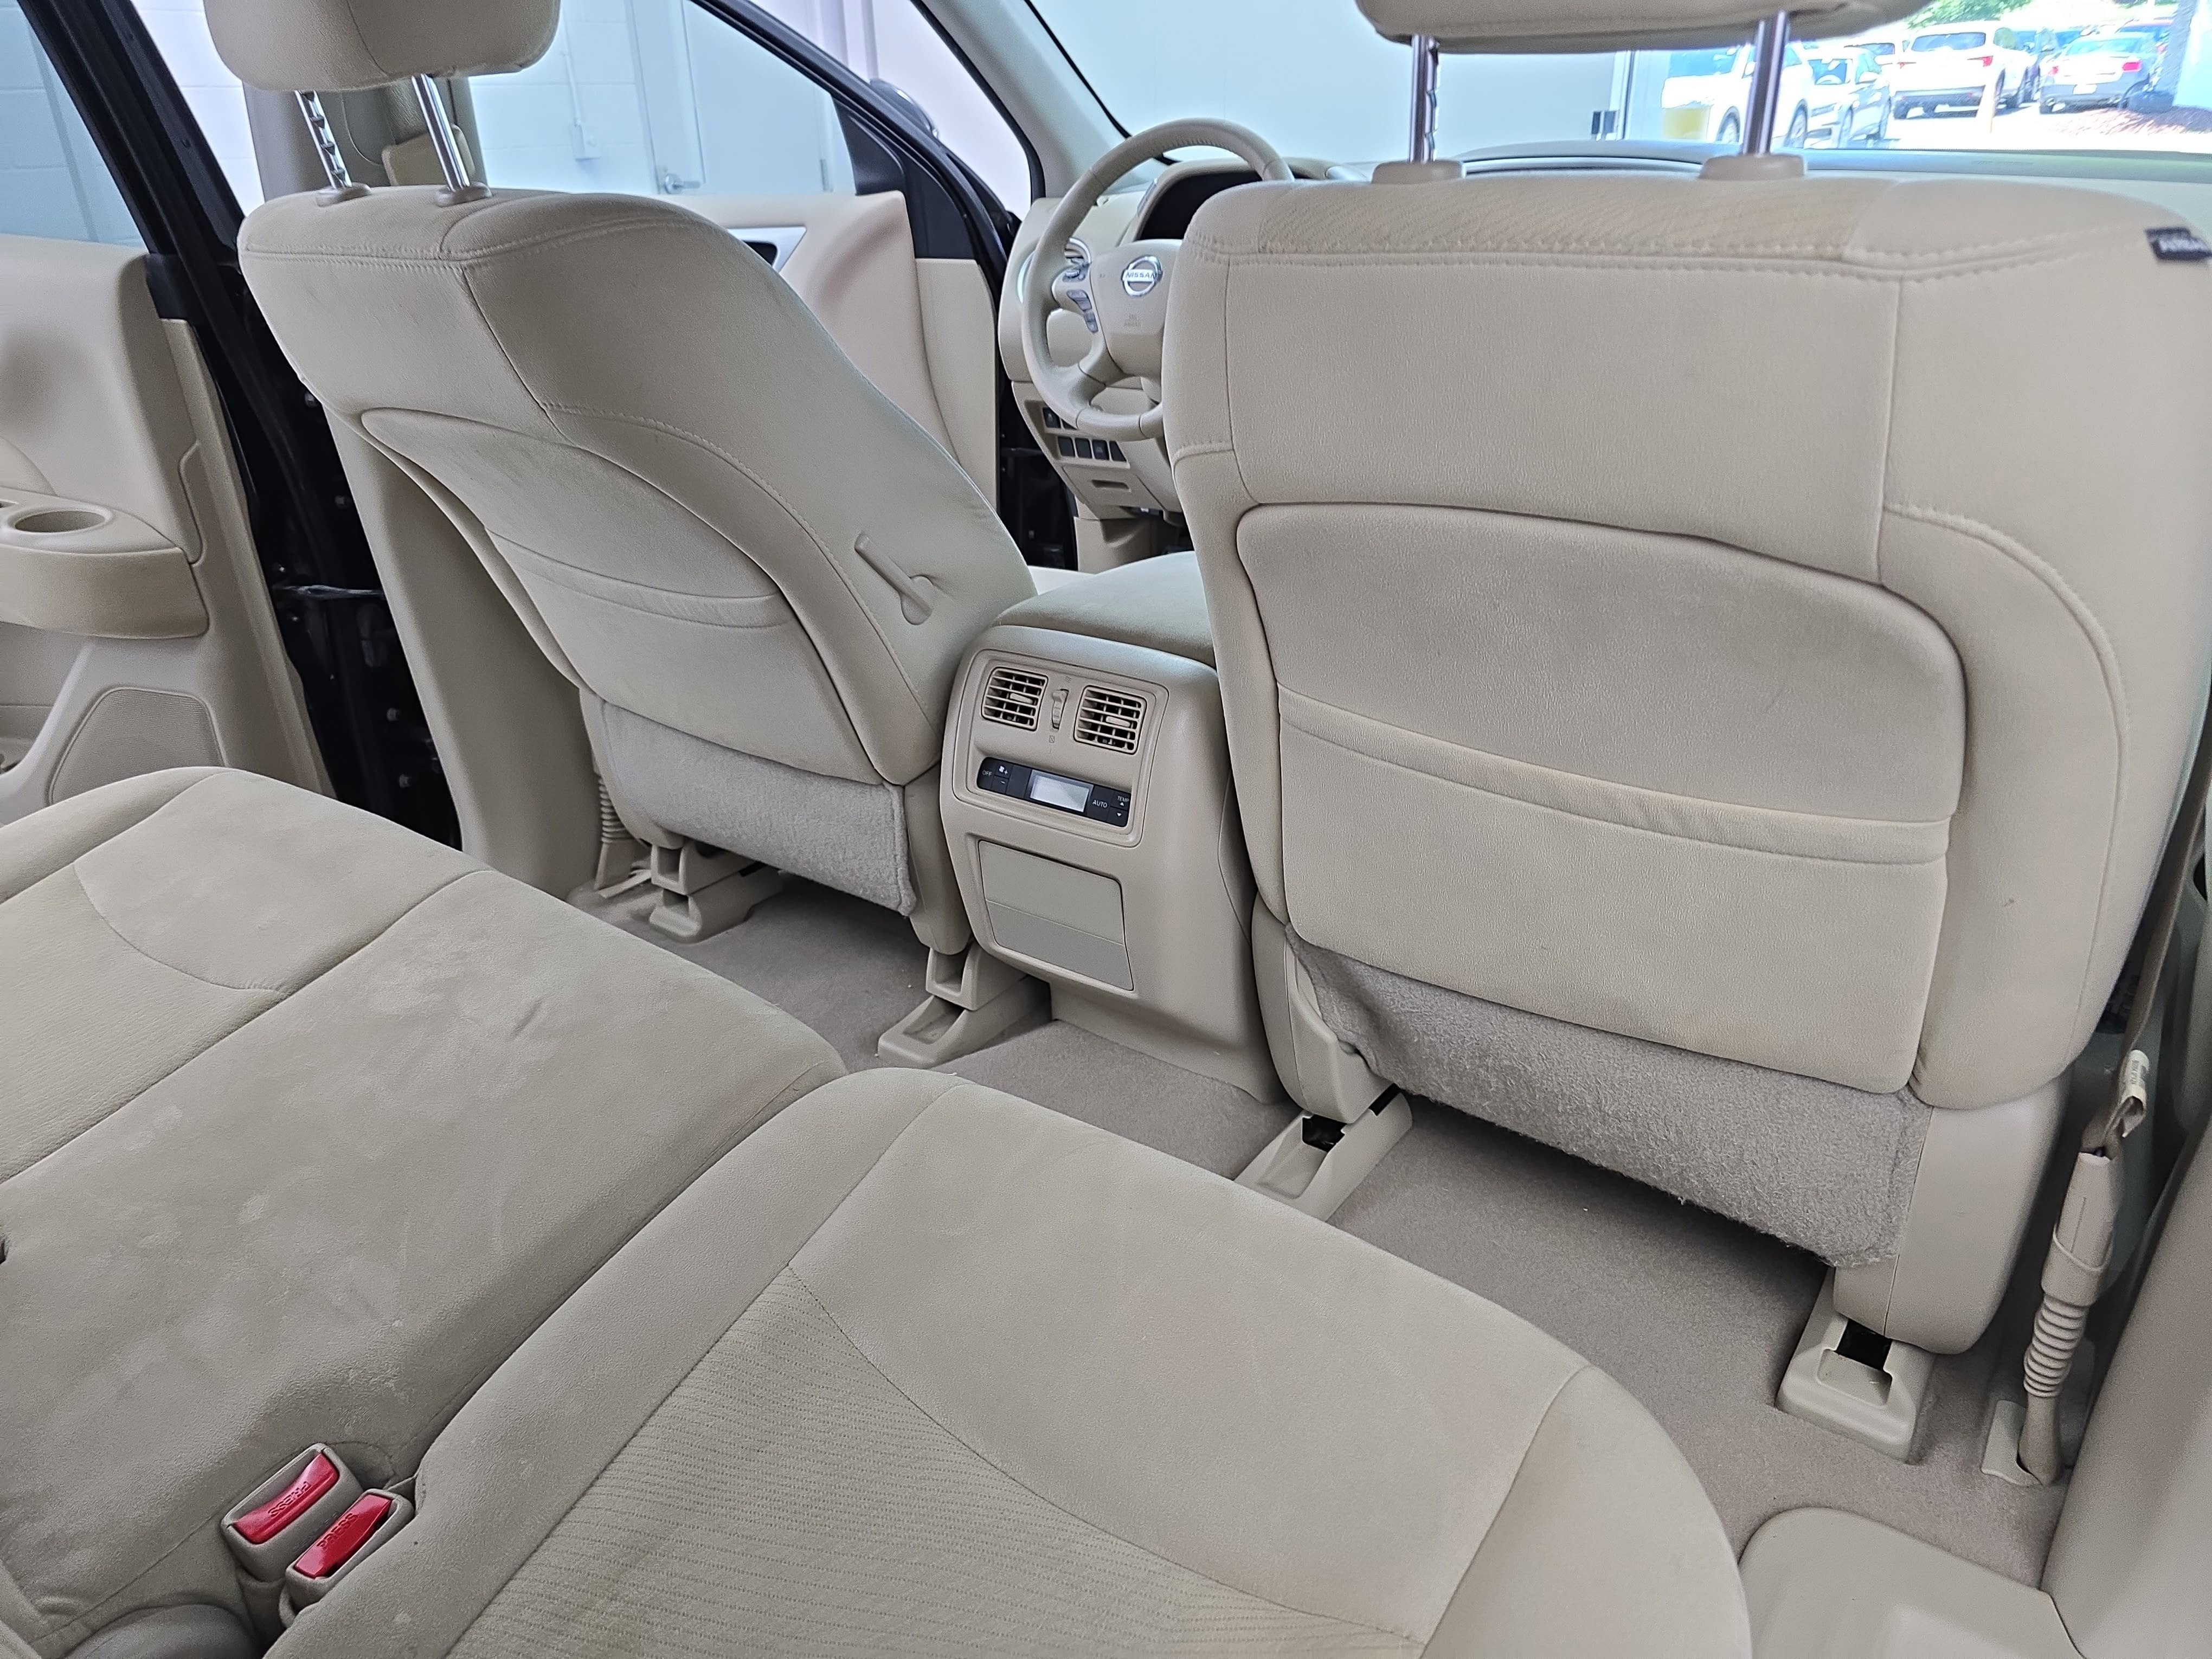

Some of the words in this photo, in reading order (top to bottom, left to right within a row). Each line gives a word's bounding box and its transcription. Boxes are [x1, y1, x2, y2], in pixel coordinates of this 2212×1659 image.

[1092, 800, 1108, 808] AUTO
[267, 1481, 312, 1518] PRESS
[317, 1512, 359, 1549] PRESS
